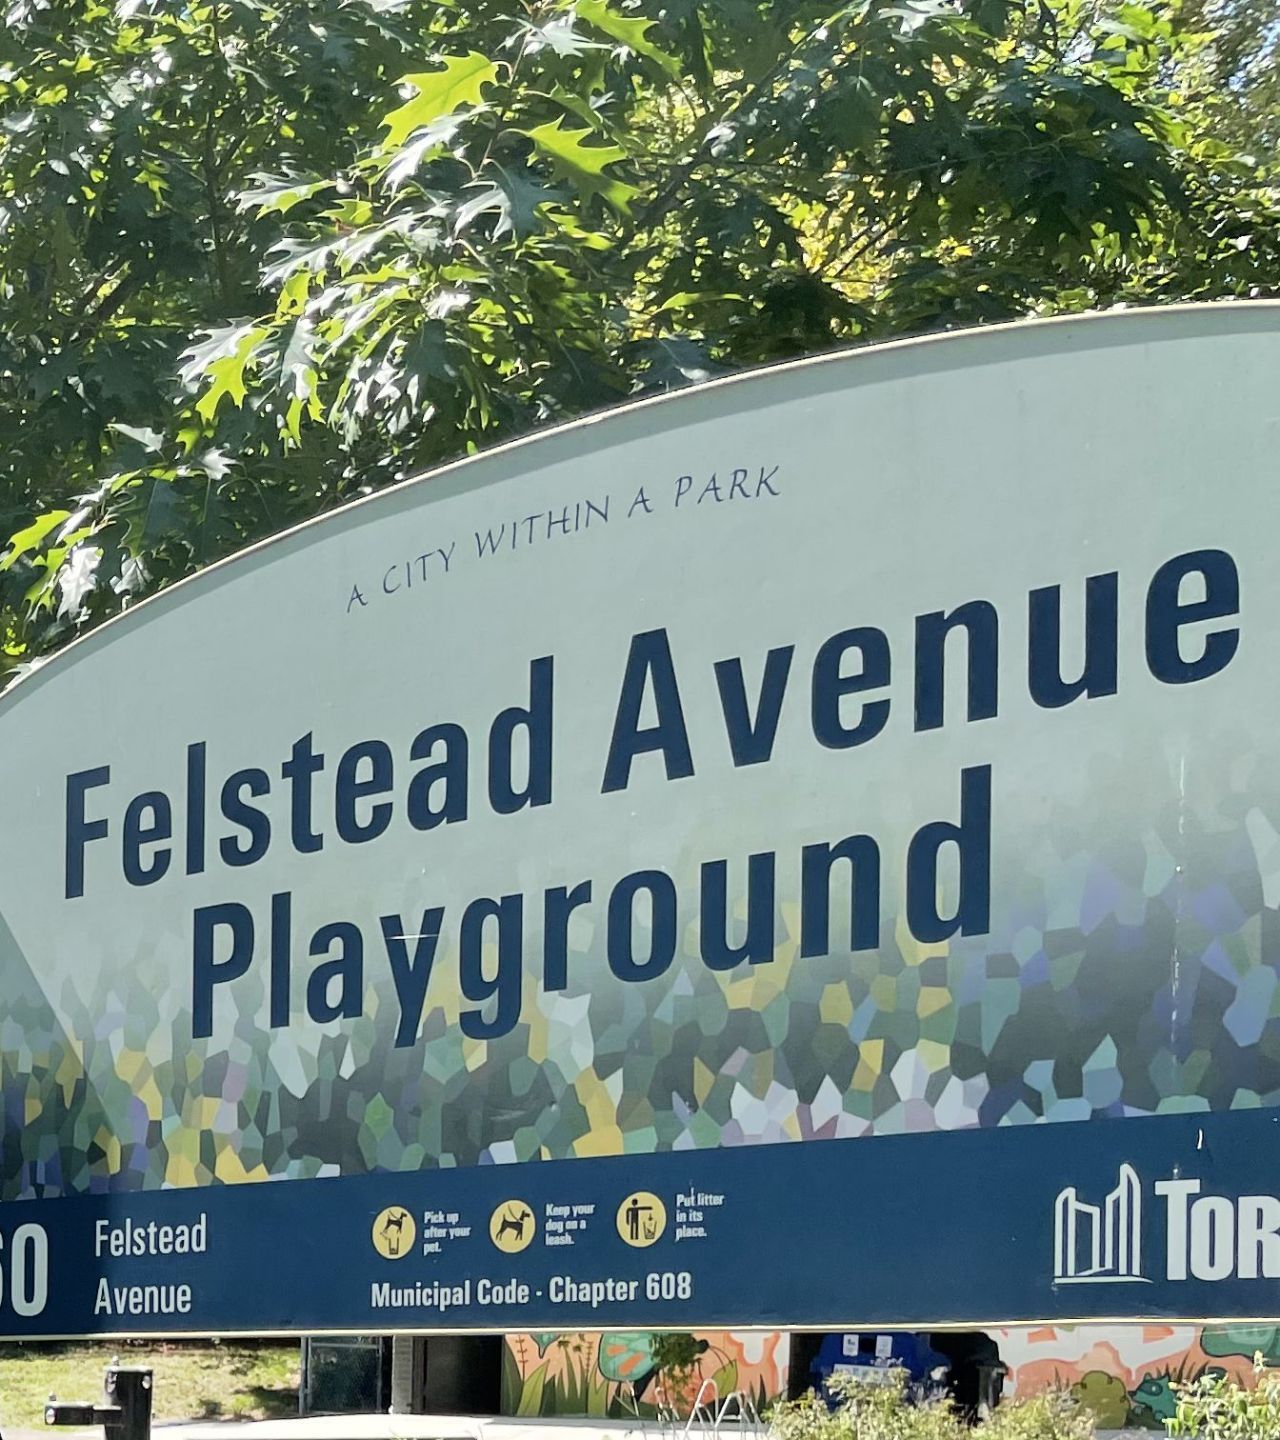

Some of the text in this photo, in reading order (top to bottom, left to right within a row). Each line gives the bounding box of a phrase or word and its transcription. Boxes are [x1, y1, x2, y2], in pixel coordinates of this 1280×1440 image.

[347, 465, 781, 612] A CITY WITHIN A PARK
[65, 548, 1241, 899] Felstead Avenue
[191, 765, 992, 1048] Playground
[676, 1193, 724, 1207] Put litter
[424, 1211, 459, 1225] Pick up
[545, 1203, 595, 1218] Keep your
[676, 1209, 703, 1222] in its
[424, 1226, 471, 1239] after your
[545, 1219, 586, 1233] dog on a
[675, 1225, 707, 1241] place.
[95, 1213, 206, 1257] Felstead
[545, 1233, 574, 1246] leash.
[424, 1242, 442, 1256] pet.
[94, 1277, 191, 1315] Avenue
[371, 1279, 470, 1311] Municipal
[477, 1278, 529, 1305] Code
[549, 1276, 638, 1308] Chapter
[646, 1272, 691, 1300] 608
